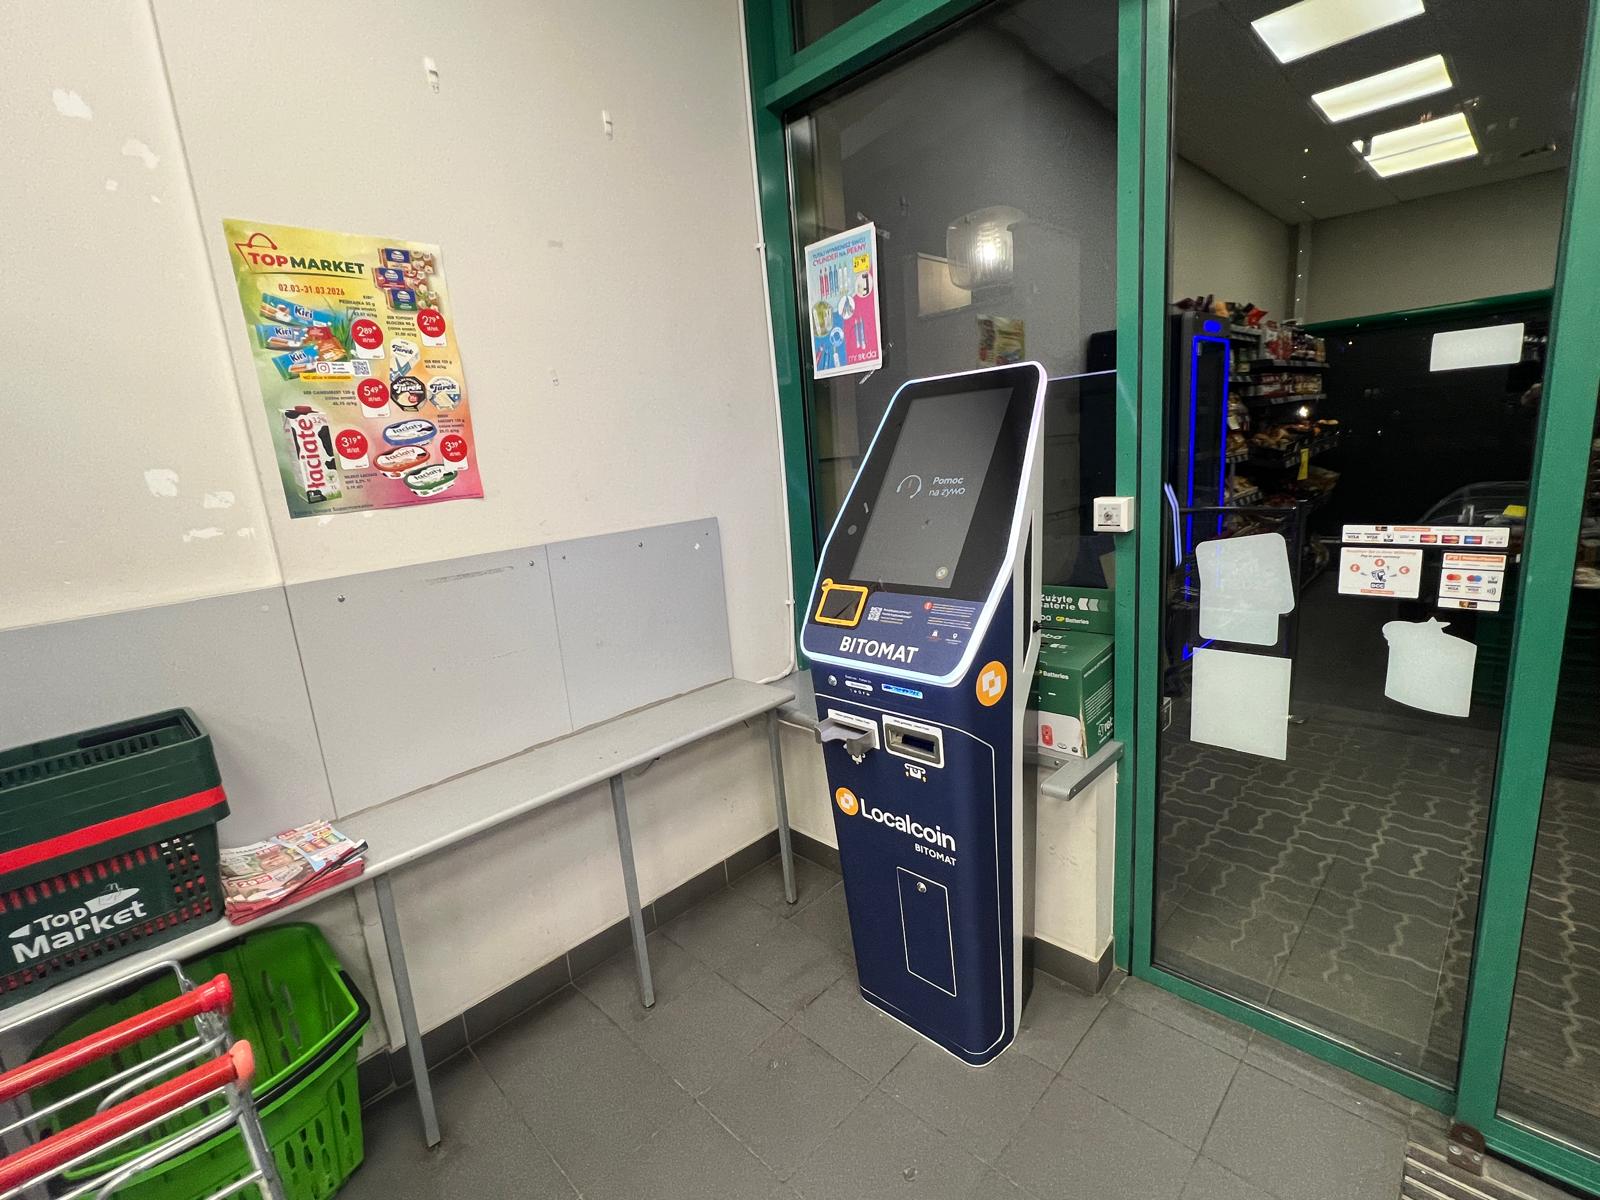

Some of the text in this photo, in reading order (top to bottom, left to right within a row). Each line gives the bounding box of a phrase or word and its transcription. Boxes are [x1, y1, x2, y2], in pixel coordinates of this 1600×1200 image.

[294, 305, 313, 319] Kiri
[275, 328, 292, 336] Kiri
[290, 351, 307, 362] Kiri
[393, 384, 421, 394] Turek
[430, 384, 456, 393] Turek
[932, 476, 964, 486] Pomoc
[839, 636, 919, 664] BITOMAT
[1043, 670, 1070, 680] Batteries
[860, 798, 956, 851] Localcoin
[914, 843, 957, 867] BITOMAT
[11, 900, 147, 964] Market
